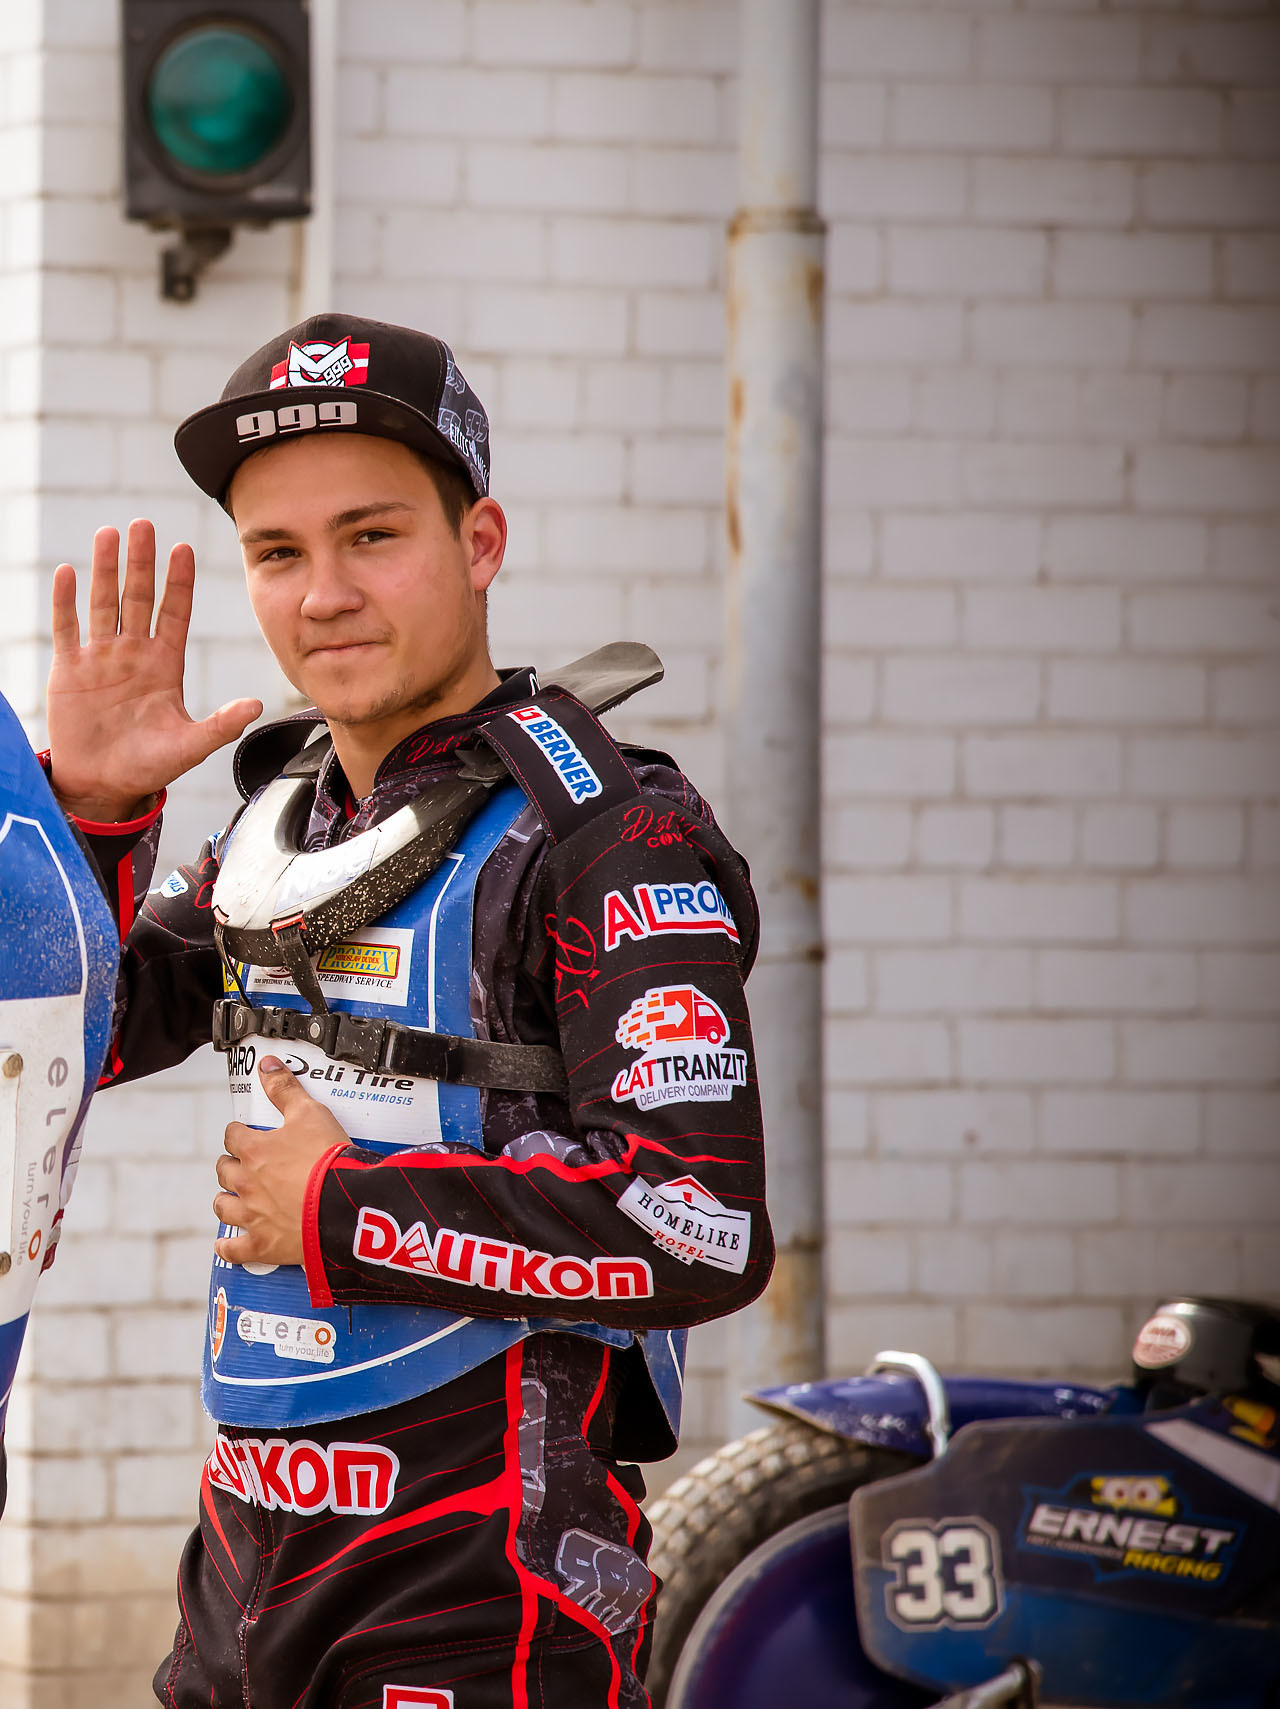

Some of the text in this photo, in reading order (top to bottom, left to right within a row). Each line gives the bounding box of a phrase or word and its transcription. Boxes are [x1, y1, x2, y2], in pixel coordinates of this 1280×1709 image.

[236, 401, 357, 443] 999
[526, 720, 598, 800] BERNER
[355, 976, 392, 989] SERVICE
[353, 1068, 415, 1091] Tire
[639, 1083, 729, 1106] DELIVERY COMPANY
[331, 1087, 414, 1106] ROAD SYMBIOSIS
[638, 1192, 740, 1251] HOMELIKE
[358, 1211, 650, 1298] DAUTKOM
[653, 1230, 705, 1259] HOTEL
[240, 1315, 332, 1346] elero
[279, 1343, 330, 1359] turn your life
[1028, 1503, 1235, 1555] ERNEST
[885, 1522, 1000, 1625] 33
[1123, 1548, 1223, 1582] RACING
